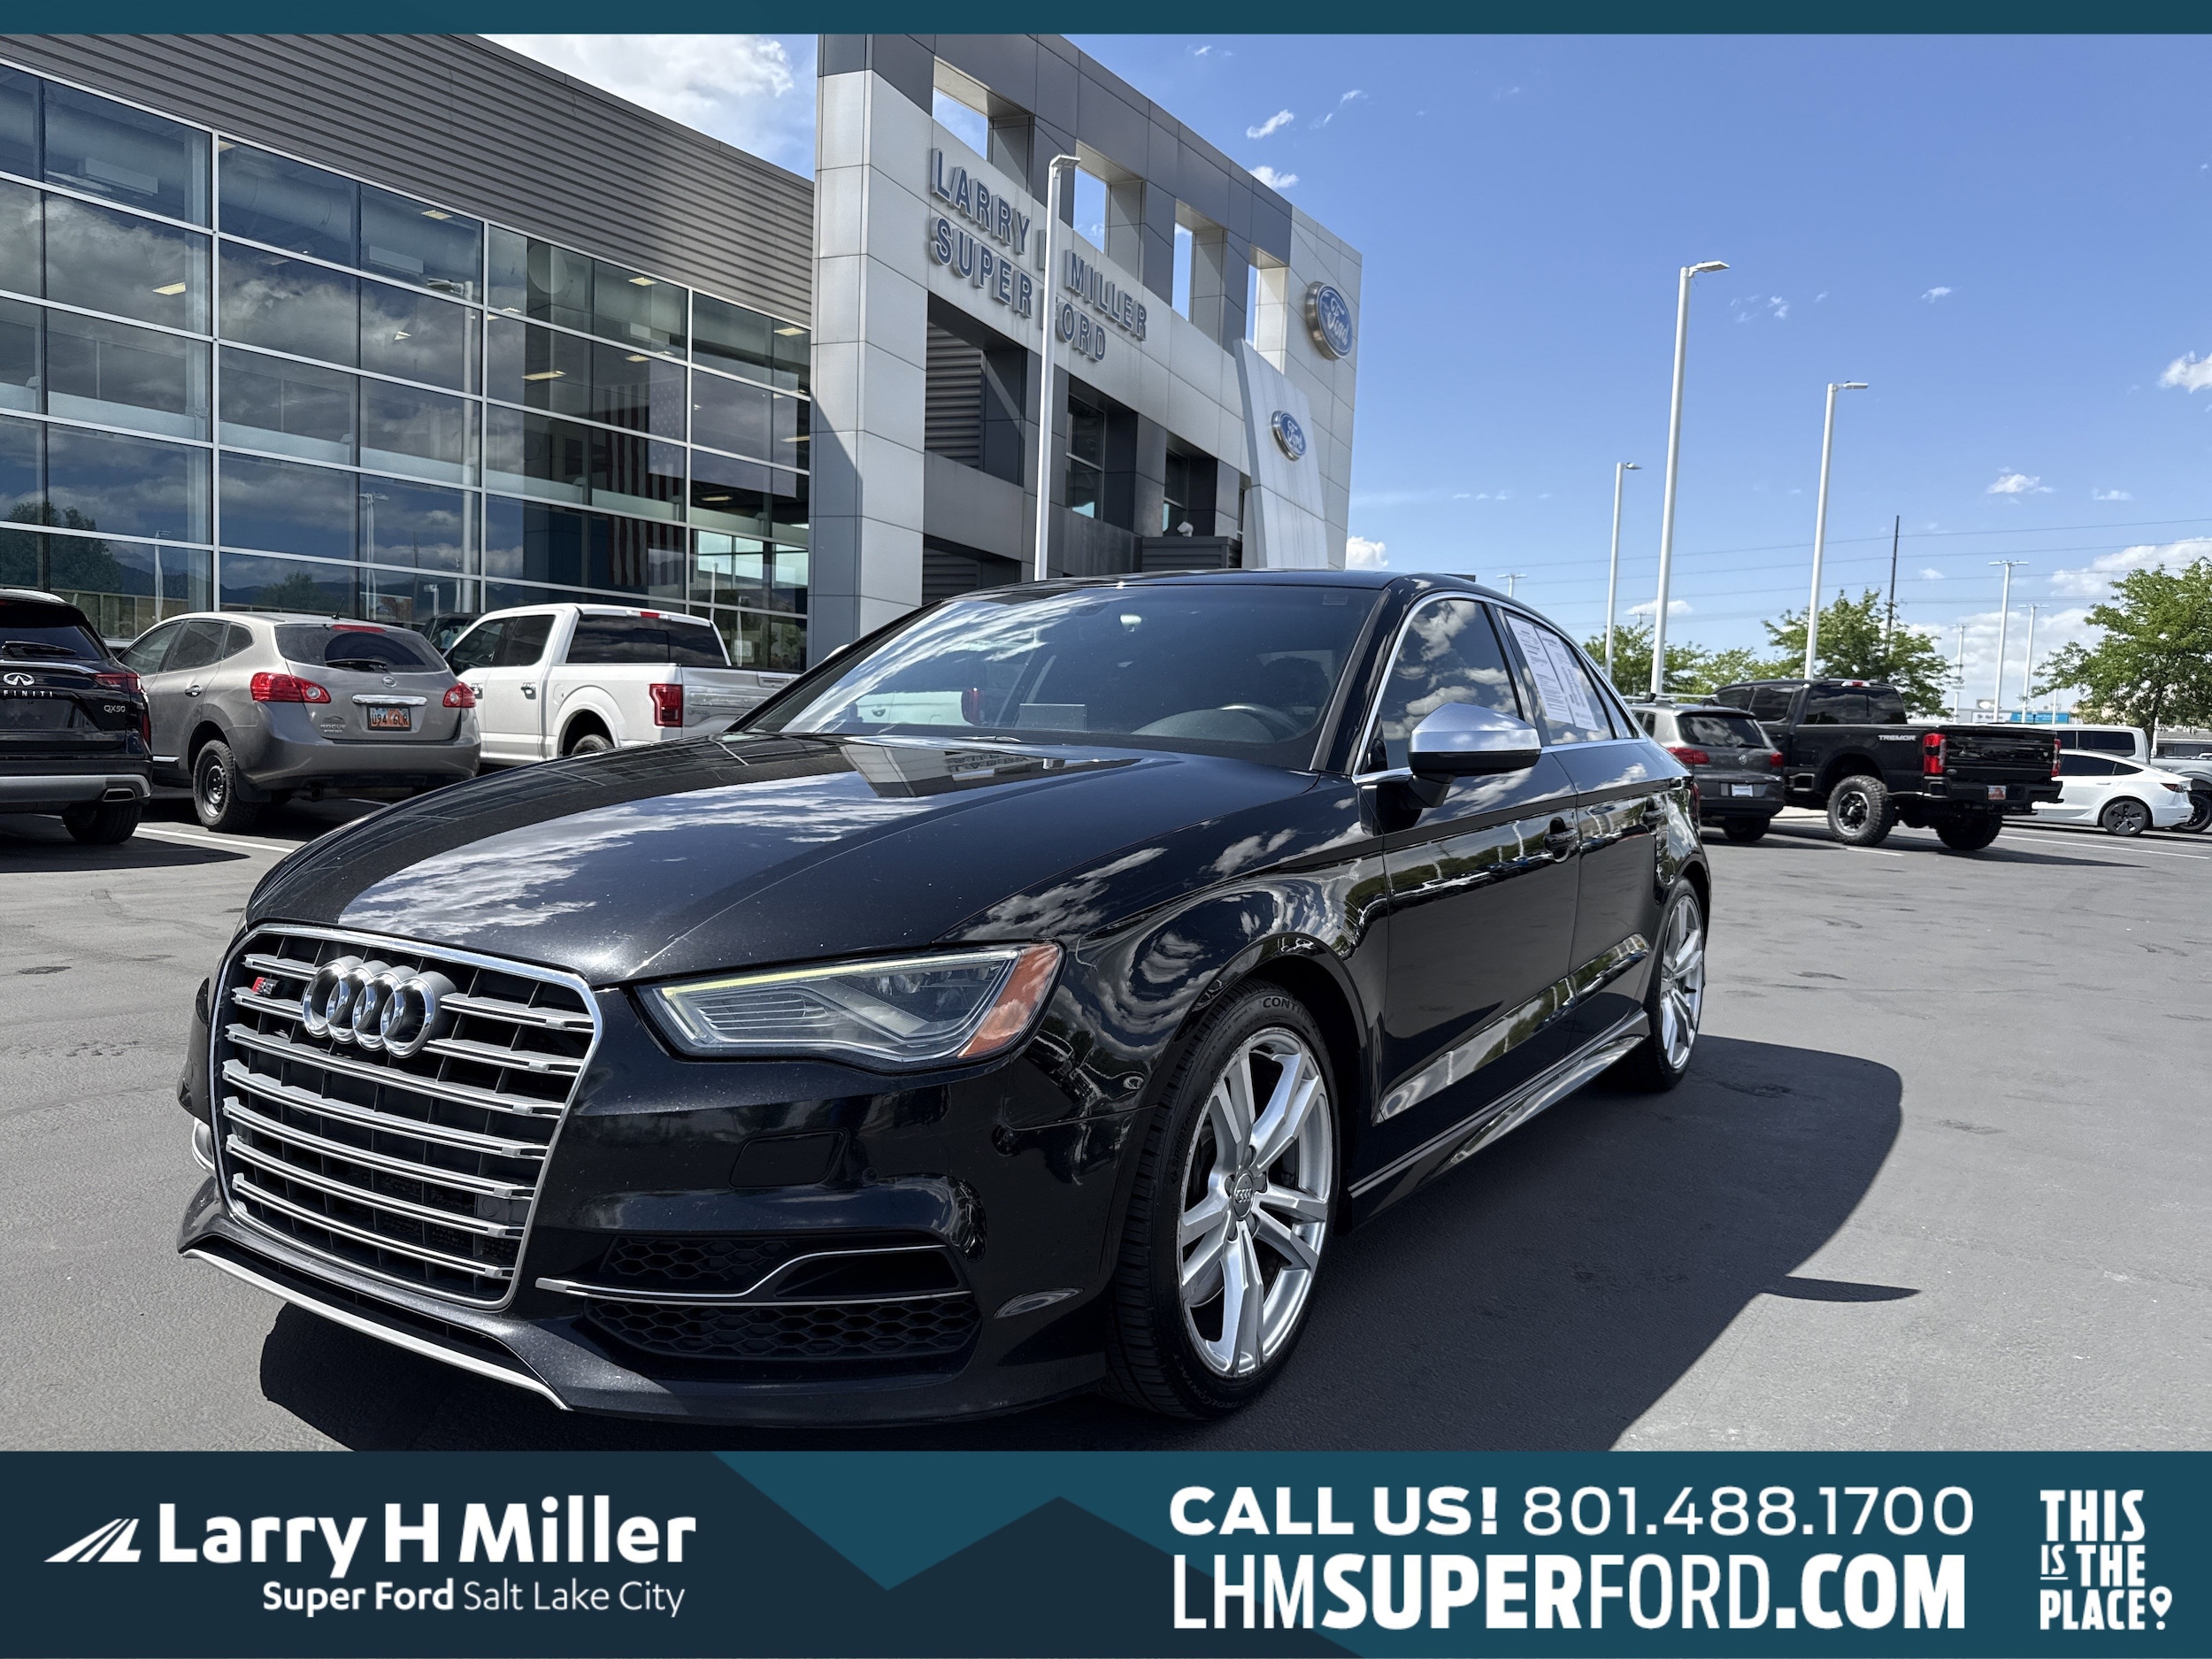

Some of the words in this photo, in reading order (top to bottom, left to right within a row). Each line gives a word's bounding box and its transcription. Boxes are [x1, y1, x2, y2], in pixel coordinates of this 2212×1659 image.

[931, 217, 1033, 319] SUPER
[1041, 289, 1106, 362] ORD
[932, 148, 1030, 255] LARRY
[1065, 250, 1147, 341] MILLER
[104, 704, 126, 714] QX50
